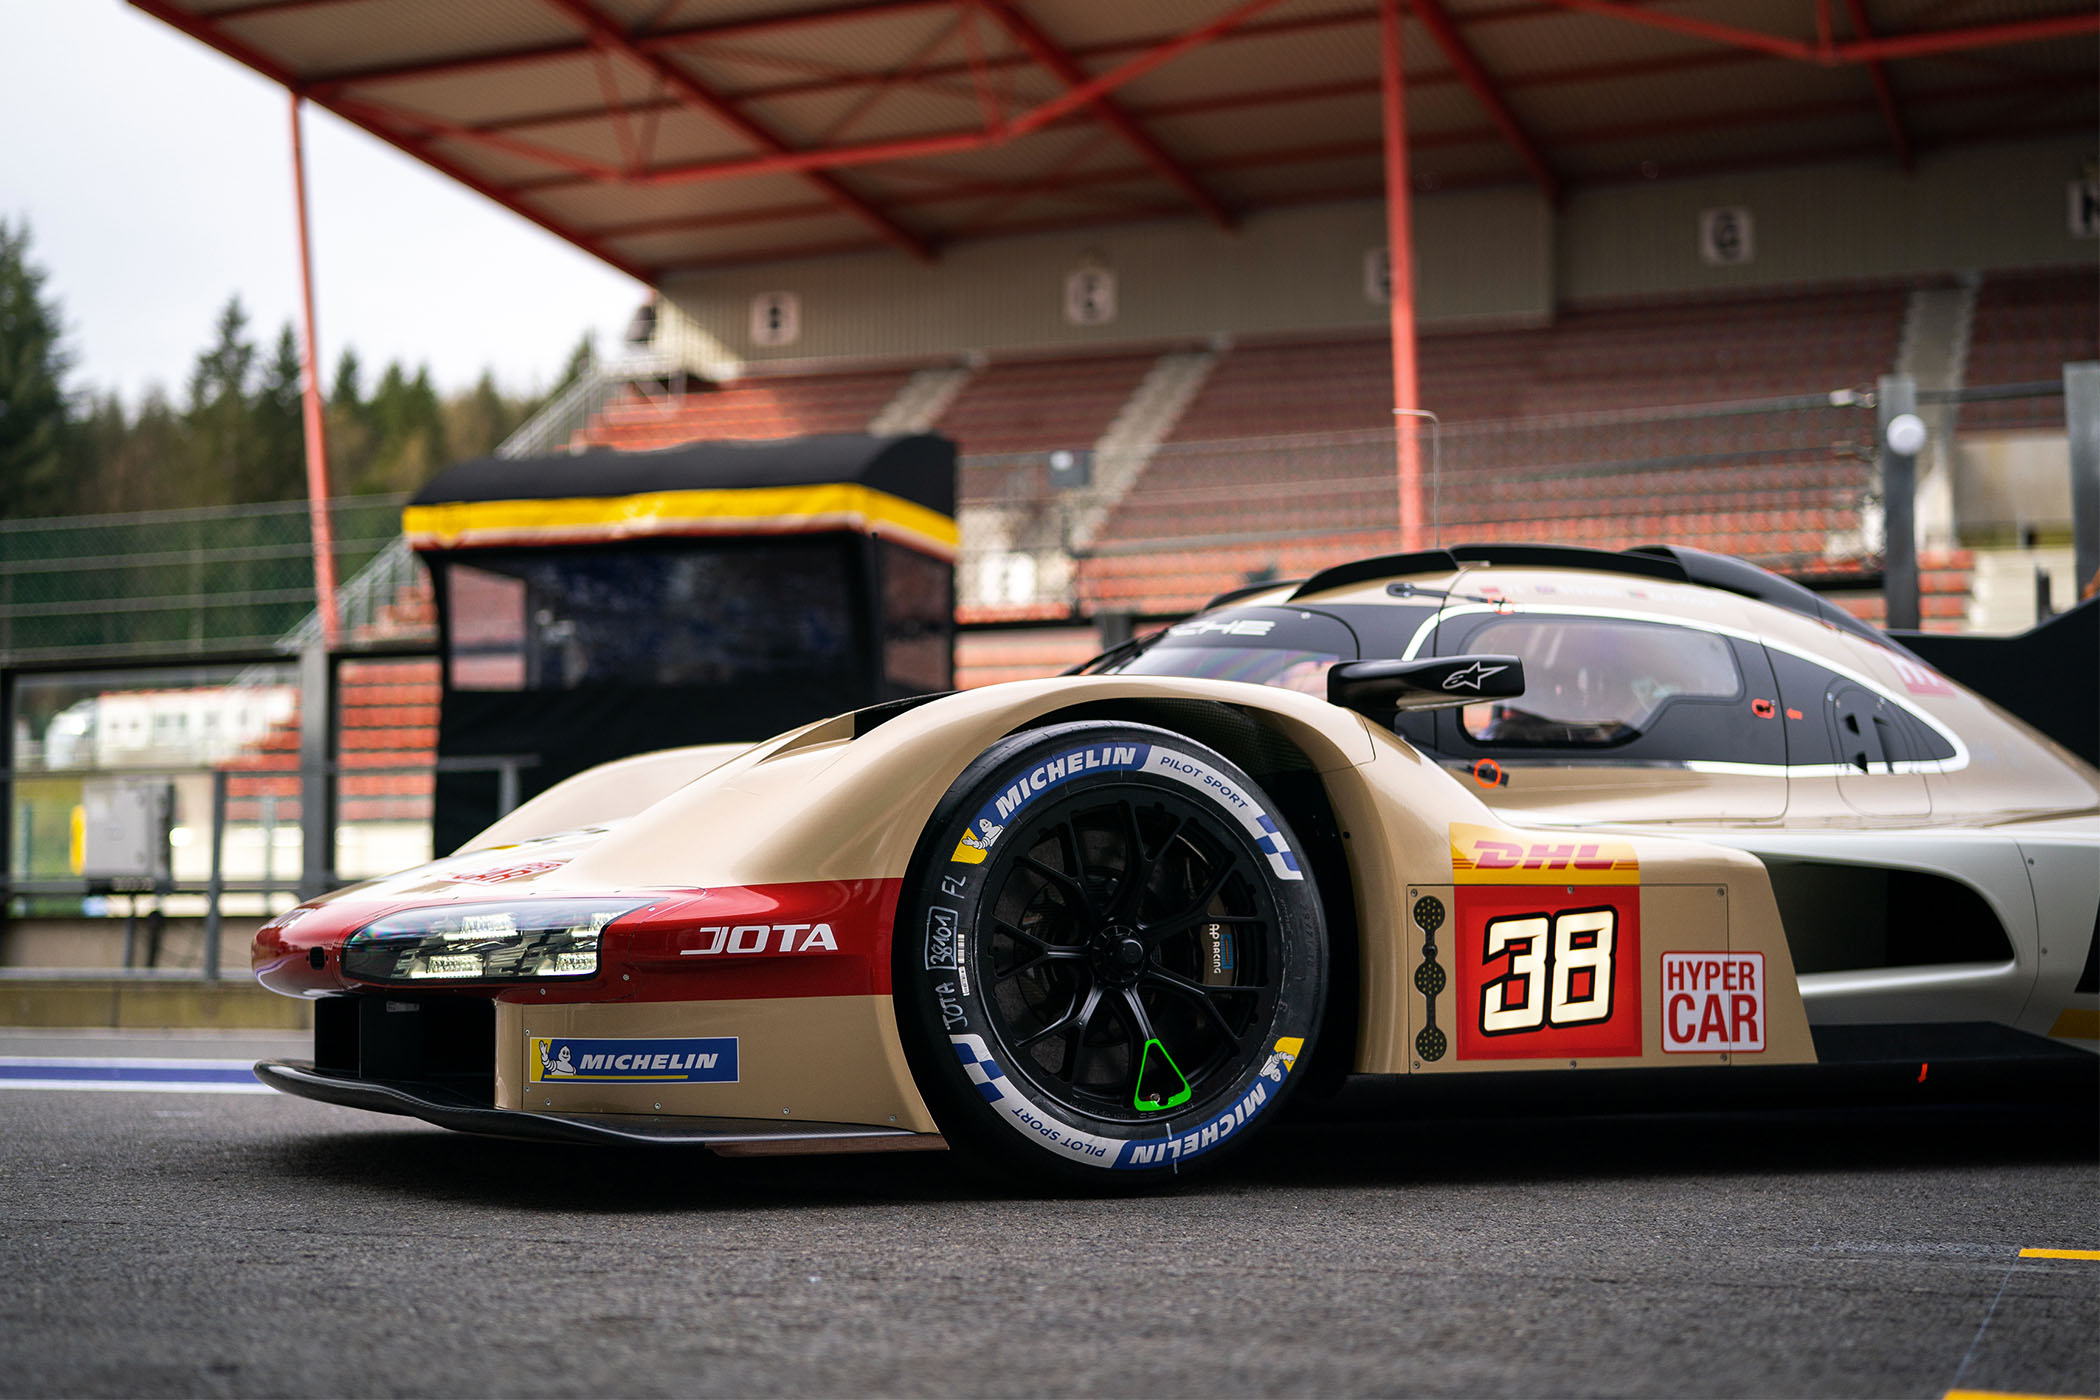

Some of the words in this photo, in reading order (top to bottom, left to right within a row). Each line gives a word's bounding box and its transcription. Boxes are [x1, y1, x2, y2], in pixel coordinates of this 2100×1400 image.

[995, 747, 1137, 820] MICHELIN
[1160, 756, 1203, 777] PILOT
[1203, 775, 1248, 808] SPORT
[1473, 840, 1614, 870] DHL
[941, 875, 966, 899] FL
[680, 923, 838, 955] JOTA
[1213, 941, 1222, 974] RACING
[1478, 904, 1619, 1037] 38
[1667, 961, 1755, 991] HYPER
[1668, 993, 1759, 1043] CAR
[579, 1053, 719, 1070] MICHELIN
[1011, 1107, 1061, 1141] SPORT
[1129, 1082, 1267, 1164] MICHELIN
[1060, 1137, 1107, 1158] PILOT
